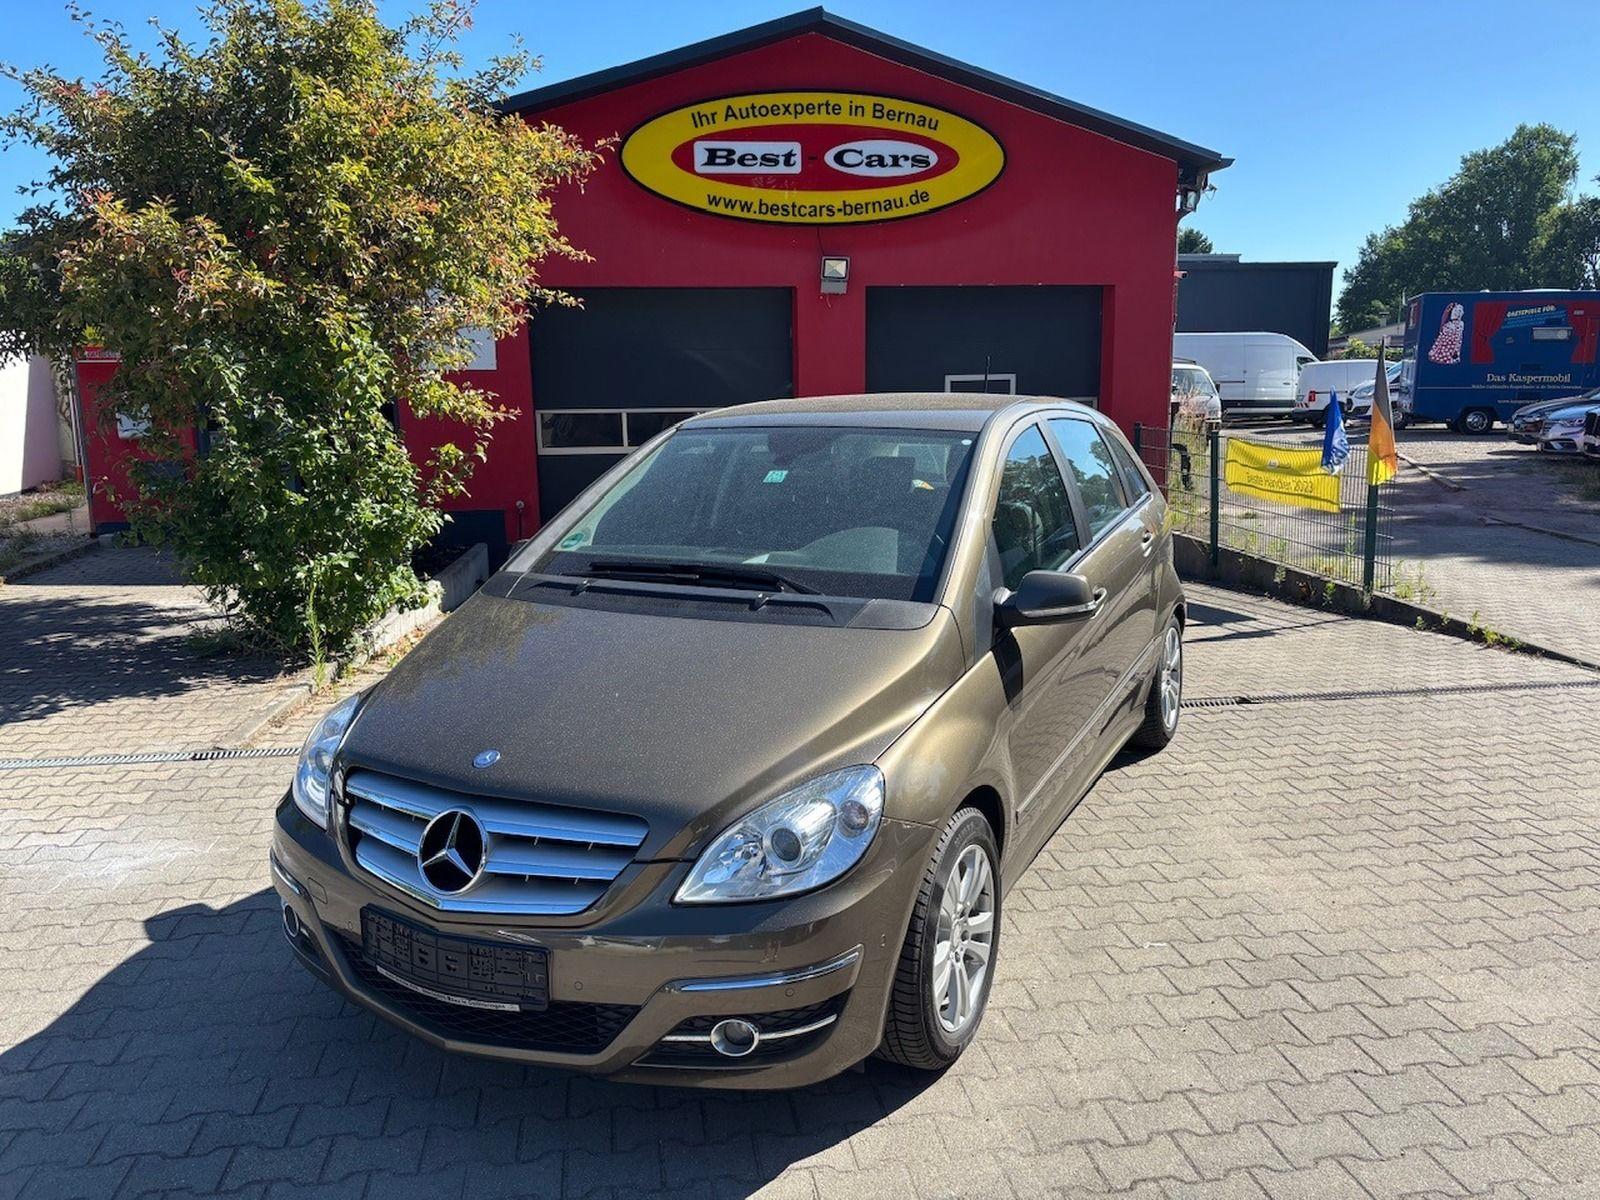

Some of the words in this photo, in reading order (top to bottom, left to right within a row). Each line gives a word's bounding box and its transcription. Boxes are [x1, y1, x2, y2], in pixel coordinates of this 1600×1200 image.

[691, 111, 717, 128] Ihr
[724, 101, 842, 121] Autoexperte
[849, 101, 865, 117] in
[872, 103, 939, 131] Bernau
[701, 148, 797, 167] Best
[833, 148, 931, 169] Cars
[707, 189, 930, 218] www.bestcars-bernau.de
[1487, 373, 1506, 382] Das
[1509, 373, 1571, 384] Kaspermobil
